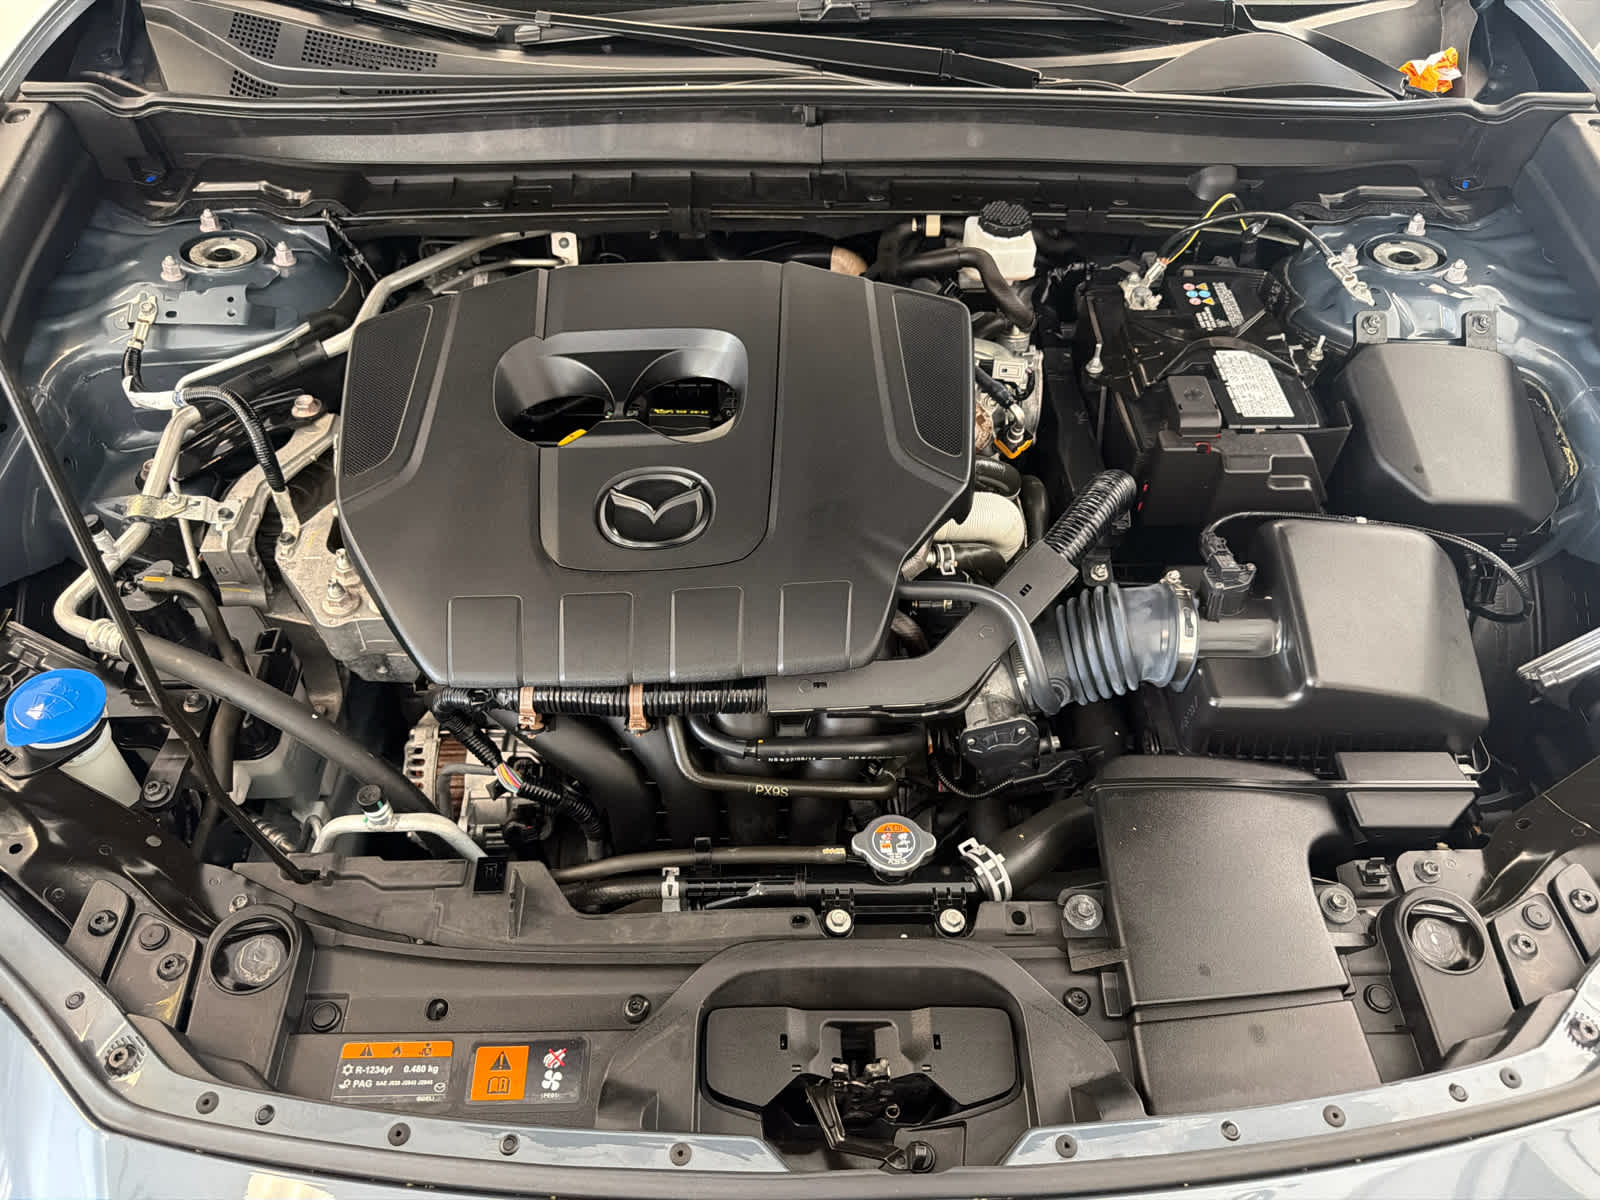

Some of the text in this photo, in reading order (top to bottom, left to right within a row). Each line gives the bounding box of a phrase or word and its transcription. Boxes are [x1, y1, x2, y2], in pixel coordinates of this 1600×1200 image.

[355, 1065, 394, 1076] R-1234yf
[427, 1064, 439, 1074] kg
[352, 1079, 373, 1089] PAG
